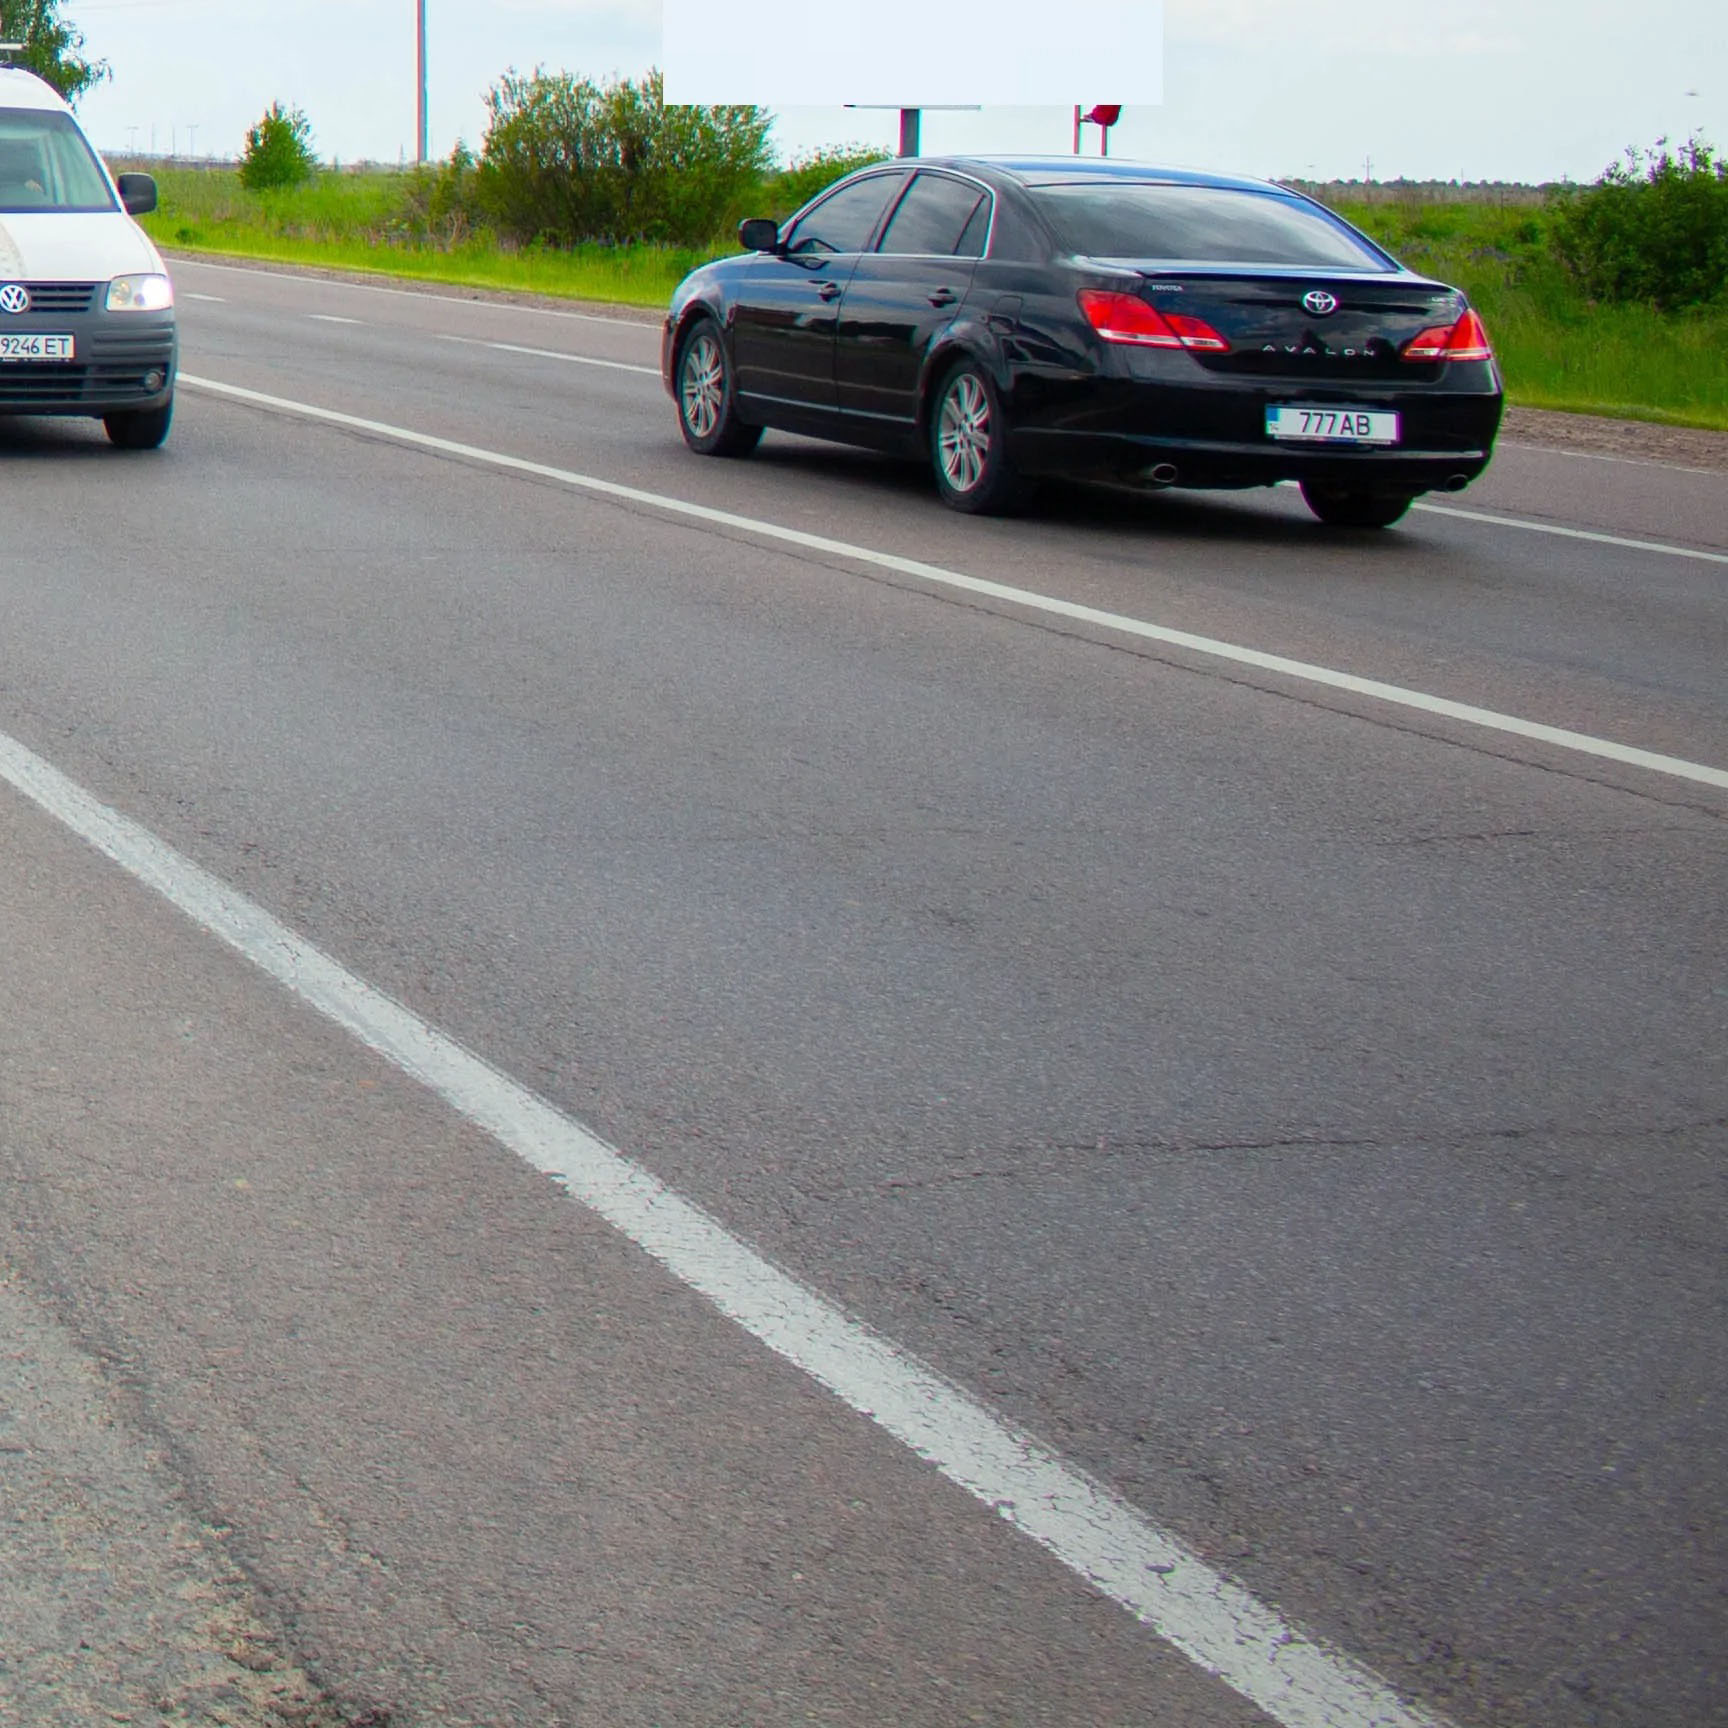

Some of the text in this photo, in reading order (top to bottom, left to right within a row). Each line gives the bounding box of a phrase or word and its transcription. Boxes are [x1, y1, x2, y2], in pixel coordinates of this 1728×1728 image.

[1, 337, 40, 354] 9246
[45, 337, 69, 355] ET
[1262, 344, 1374, 356] AVALON
